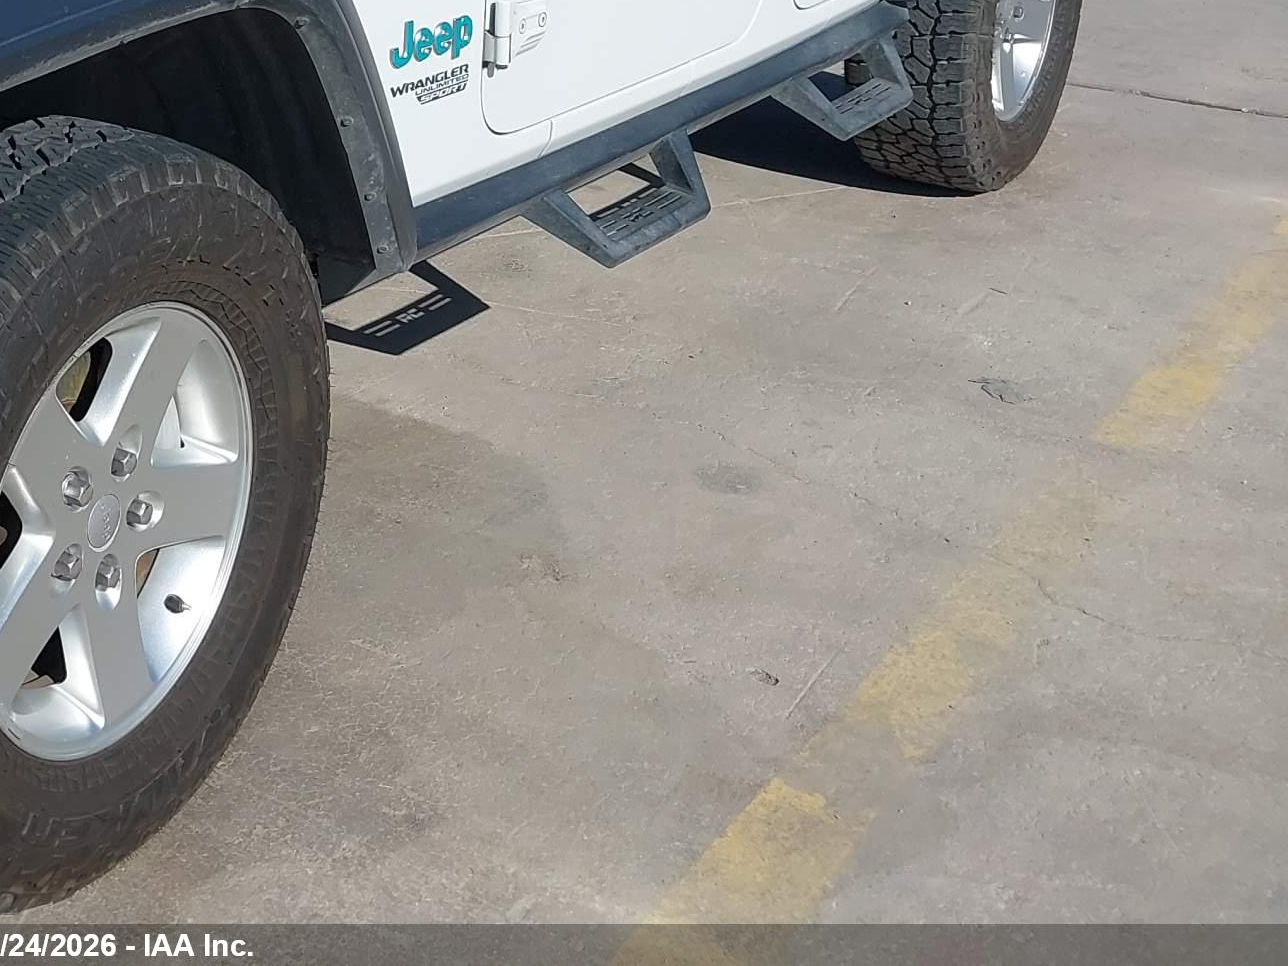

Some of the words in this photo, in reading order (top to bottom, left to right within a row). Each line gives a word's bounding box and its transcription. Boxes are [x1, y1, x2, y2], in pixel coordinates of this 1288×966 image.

[390, 15, 473, 69] Jeep
[390, 63, 469, 99] WRANGLER
[415, 74, 469, 96] UNLIMITED
